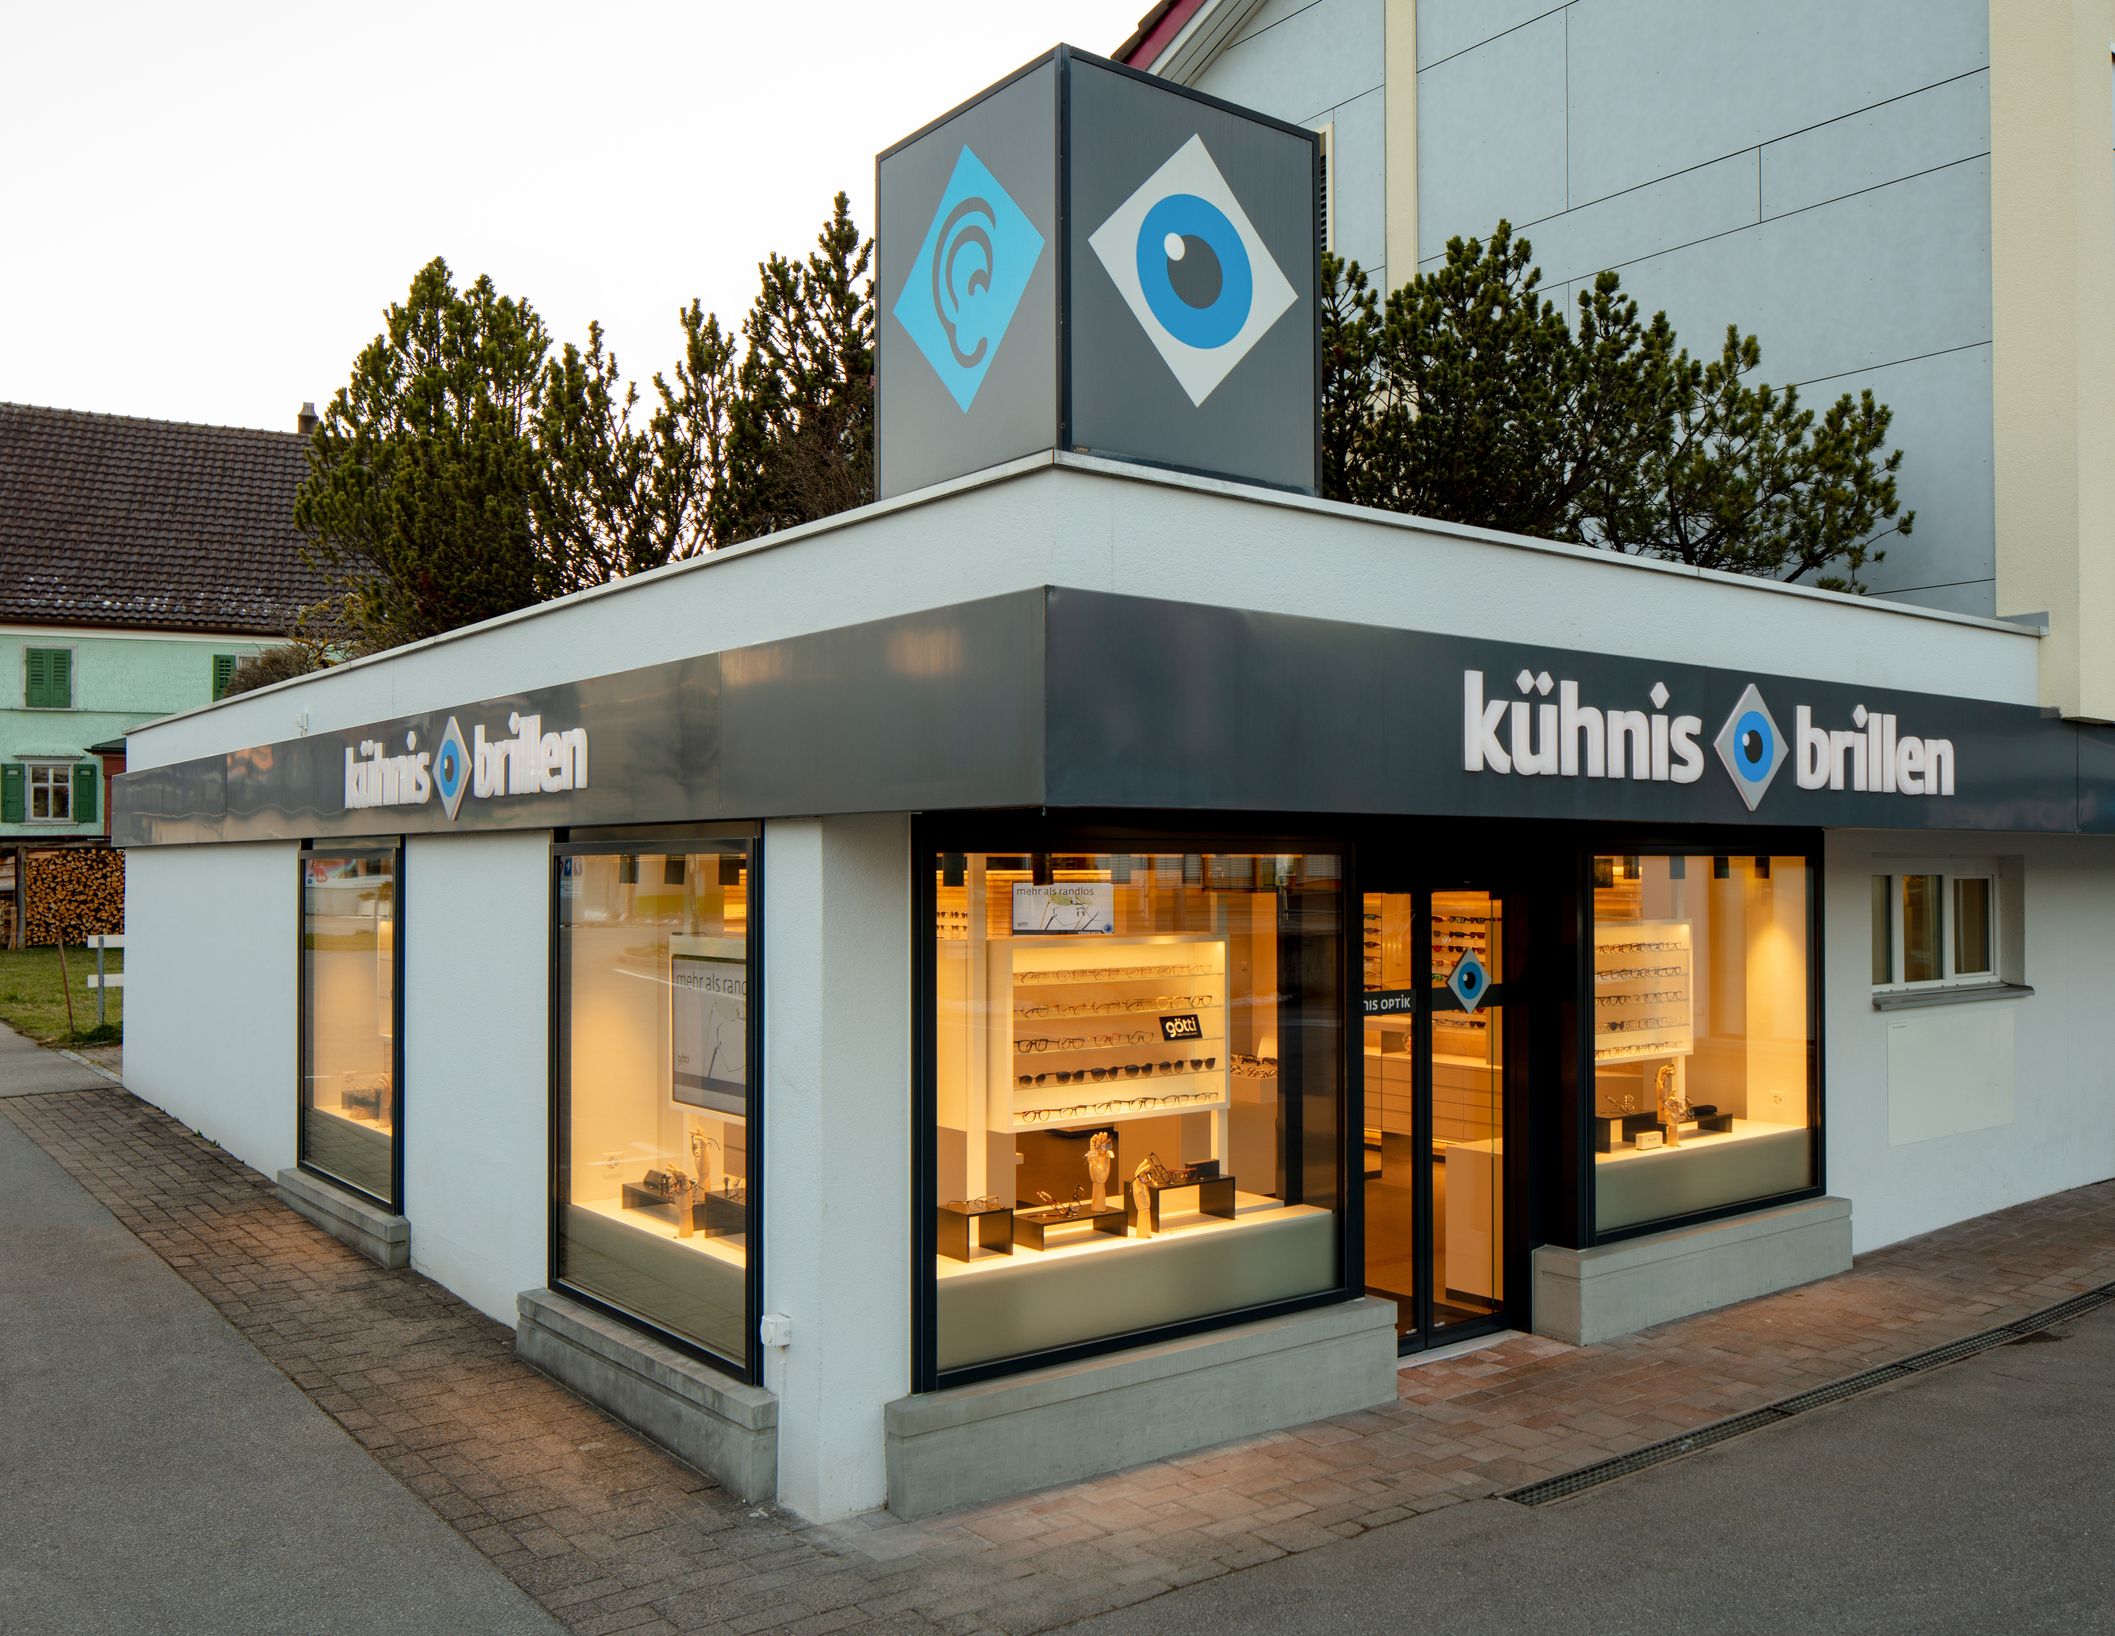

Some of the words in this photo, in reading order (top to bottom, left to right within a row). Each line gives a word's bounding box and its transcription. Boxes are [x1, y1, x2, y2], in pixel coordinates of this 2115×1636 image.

[1463, 668, 1704, 784] kühnis
[1796, 703, 1956, 796] brillen
[345, 731, 432, 809] kühnis
[474, 711, 588, 799] brillen
[1016, 887, 1041, 896] mehr
[1043, 886, 1057, 896] als
[1059, 886, 1095, 896] randlos
[676, 970, 704, 992] mehr
[705, 971, 721, 993] als
[1165, 1016, 1197, 1038] götti
